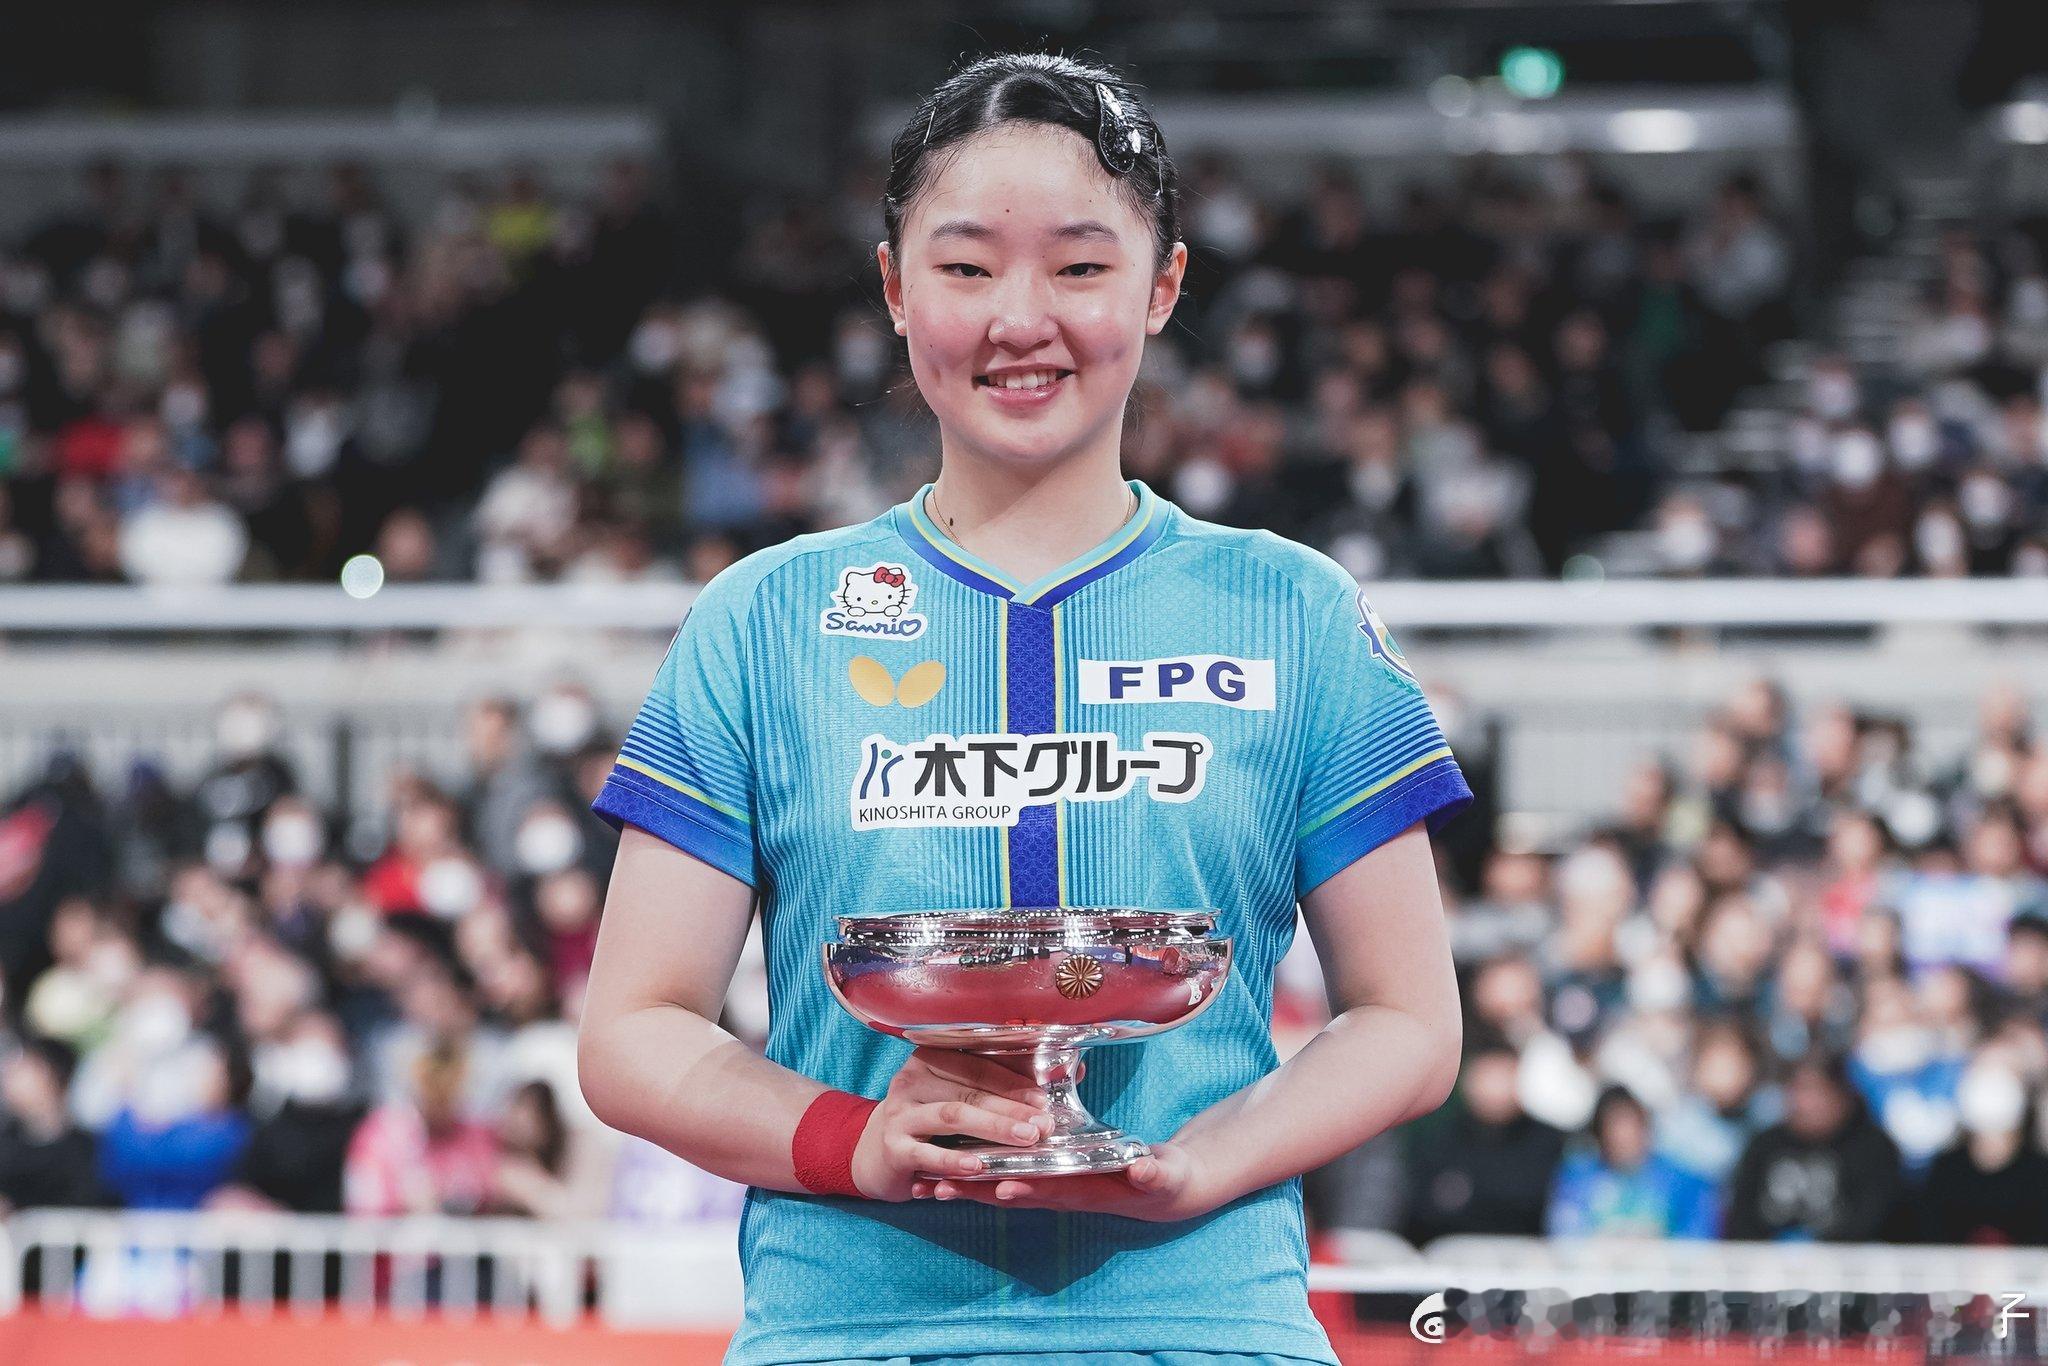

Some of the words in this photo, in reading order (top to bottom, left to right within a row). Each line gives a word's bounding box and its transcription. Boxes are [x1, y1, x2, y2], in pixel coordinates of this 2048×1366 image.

[825, 612, 922, 636] Sanrio
[1109, 660, 1246, 702] FPG
[914, 740, 1204, 797] 木下グループ
[859, 805, 947, 822] KINOSHITA
[952, 805, 1011, 819] GROUP
